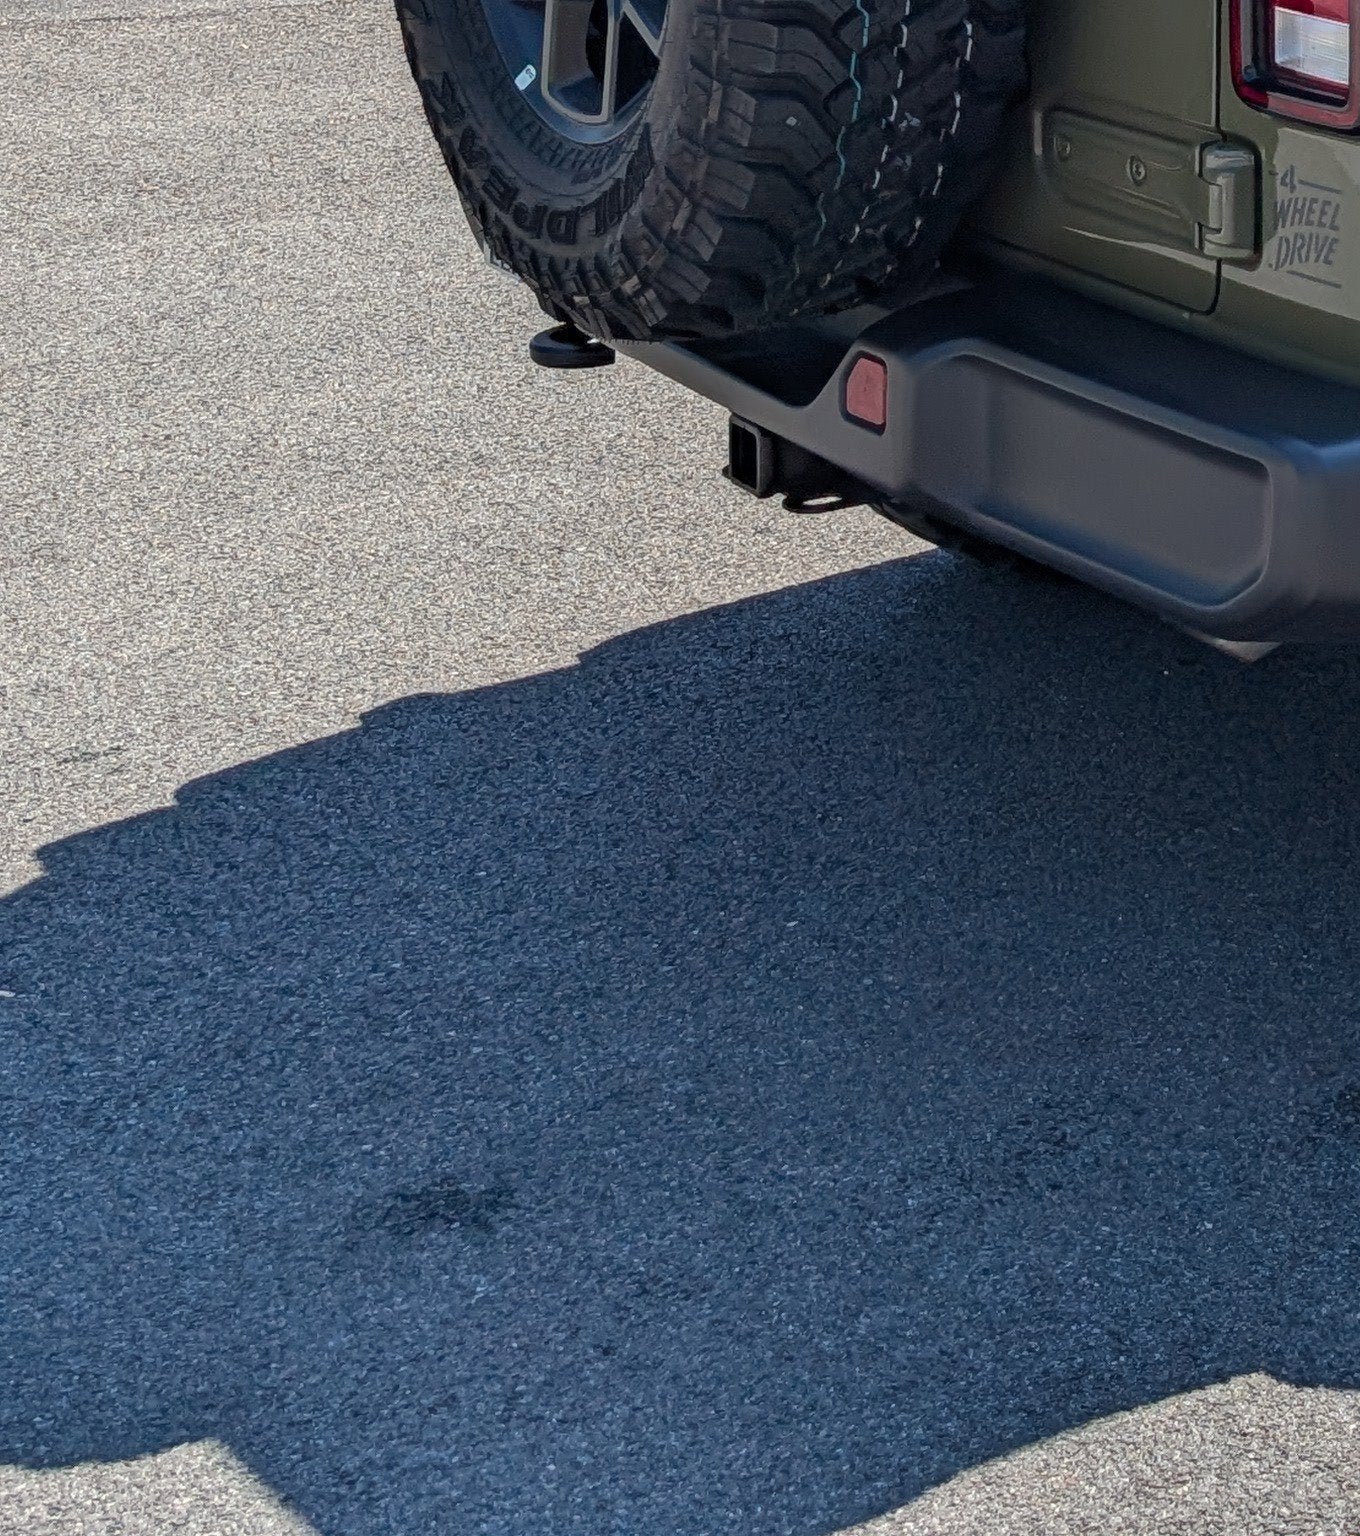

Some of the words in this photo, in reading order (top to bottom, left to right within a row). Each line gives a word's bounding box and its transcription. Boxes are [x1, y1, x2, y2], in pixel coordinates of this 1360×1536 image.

[1280, 164, 1297, 193] 4
[1274, 197, 1340, 231] WHEEL
[1274, 232, 1340, 271] DRIVE
